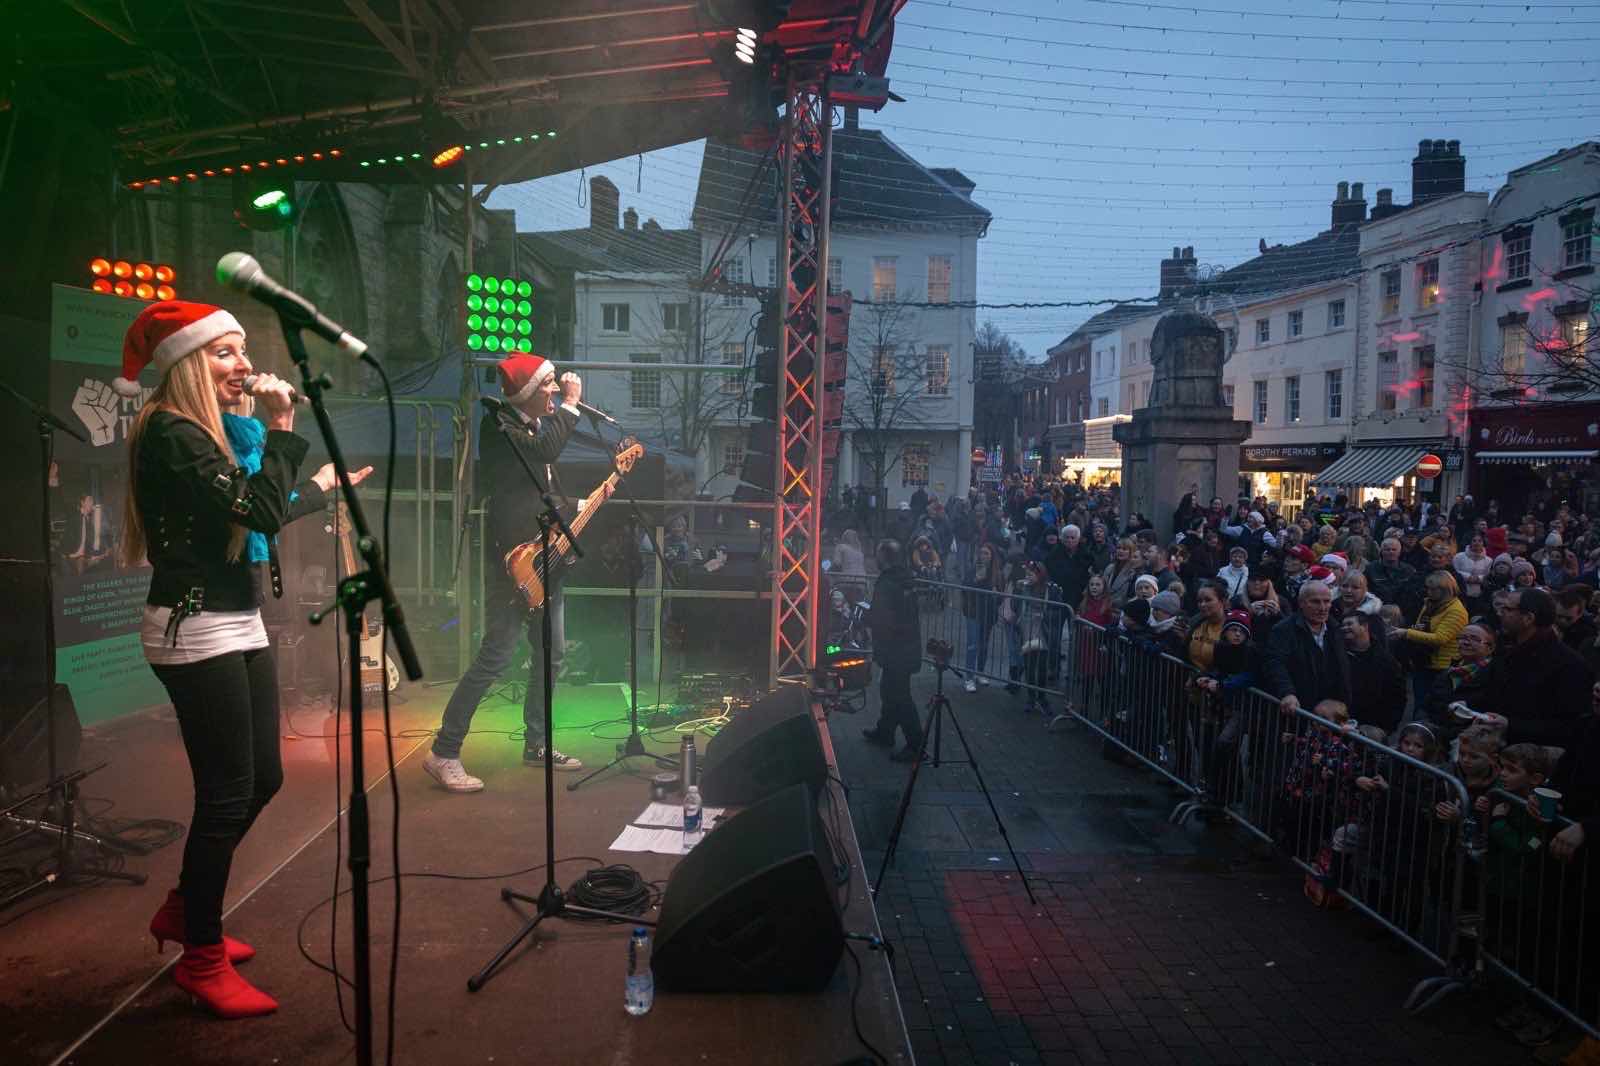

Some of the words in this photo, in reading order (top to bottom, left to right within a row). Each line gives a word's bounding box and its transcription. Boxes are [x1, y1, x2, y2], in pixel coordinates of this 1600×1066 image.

[1492, 425, 1535, 446] Birds
[1246, 447, 1281, 457] DOROTHY
[1281, 447, 1317, 457] PERKINS
